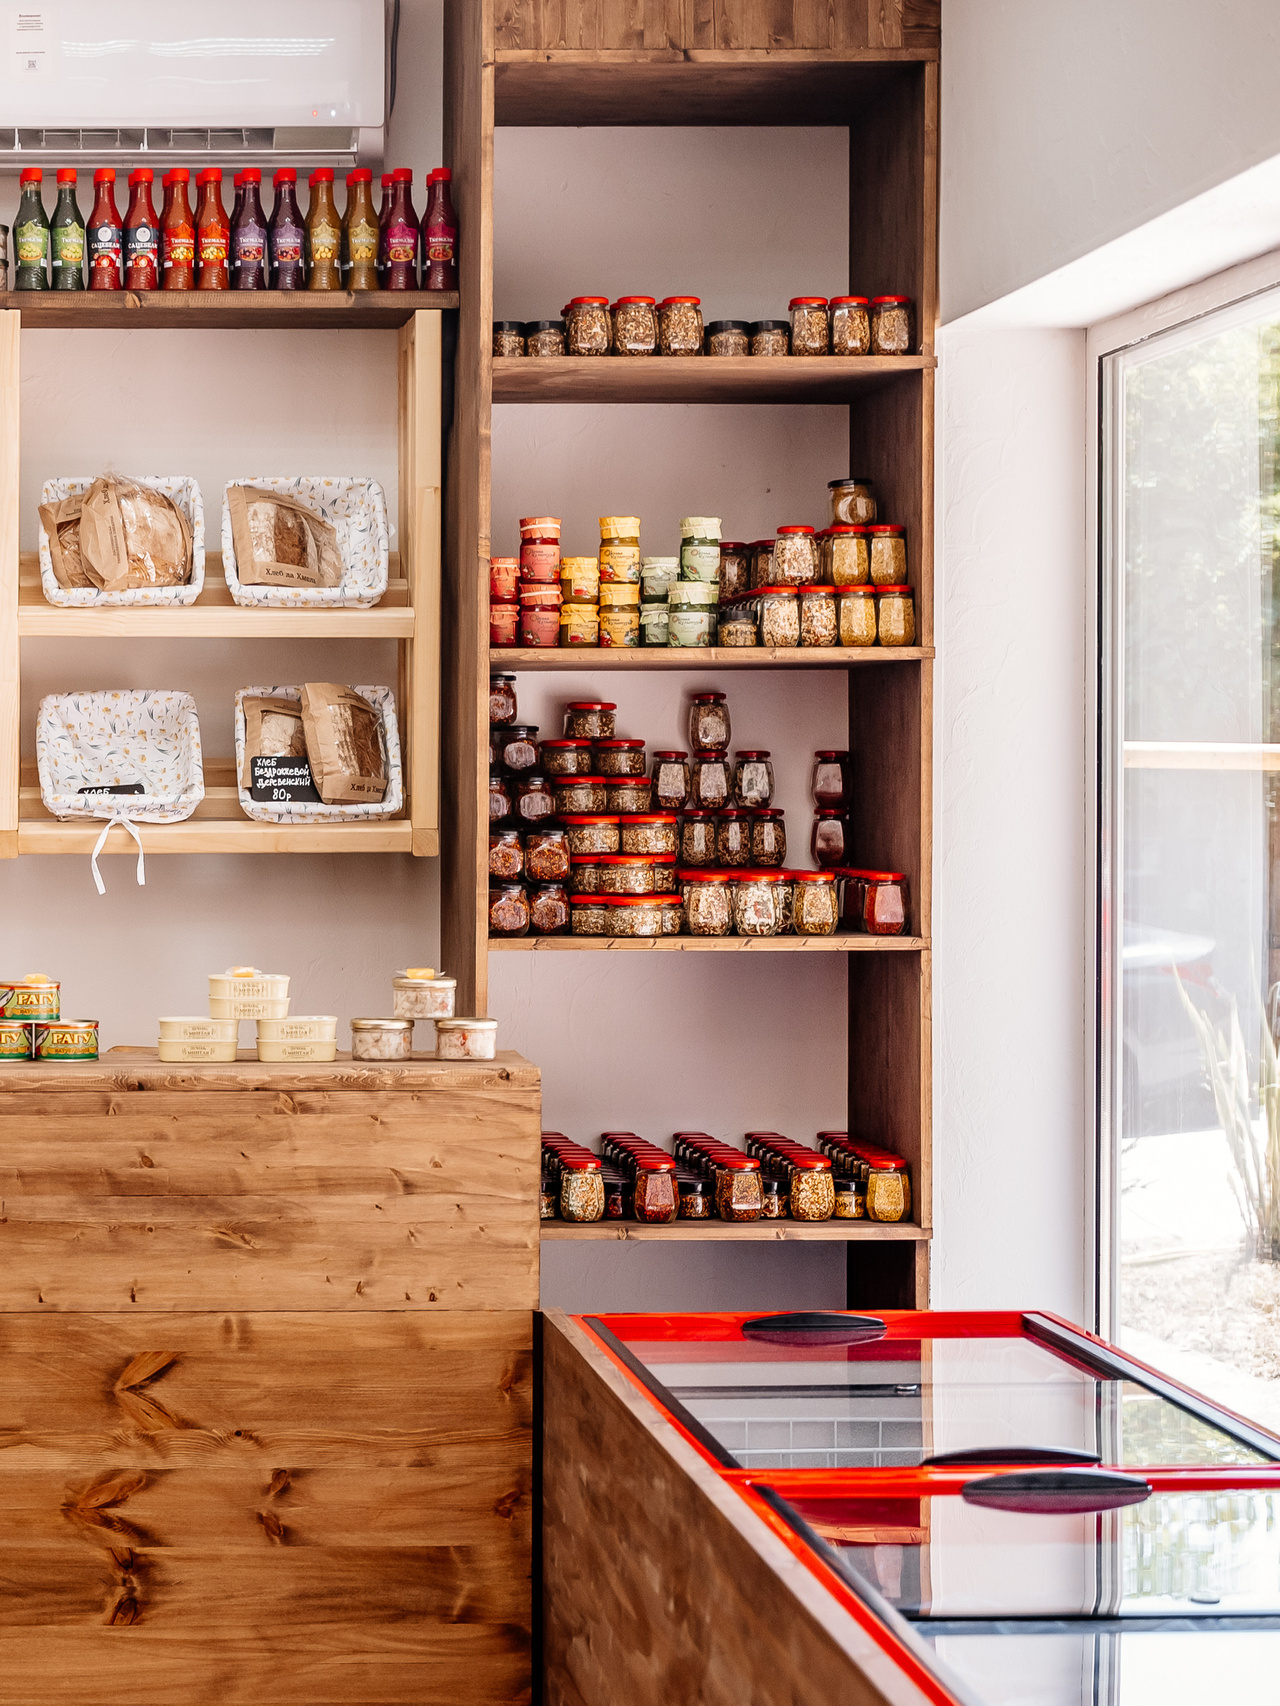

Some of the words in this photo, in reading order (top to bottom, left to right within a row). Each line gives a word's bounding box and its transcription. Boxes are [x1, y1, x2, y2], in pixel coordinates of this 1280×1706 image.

[265, 568, 284, 576] Хлеб
[296, 573, 317, 584] Хмель
[17, 993, 56, 1006] РАГУ
[52, 1033, 92, 1044] РАГУ
